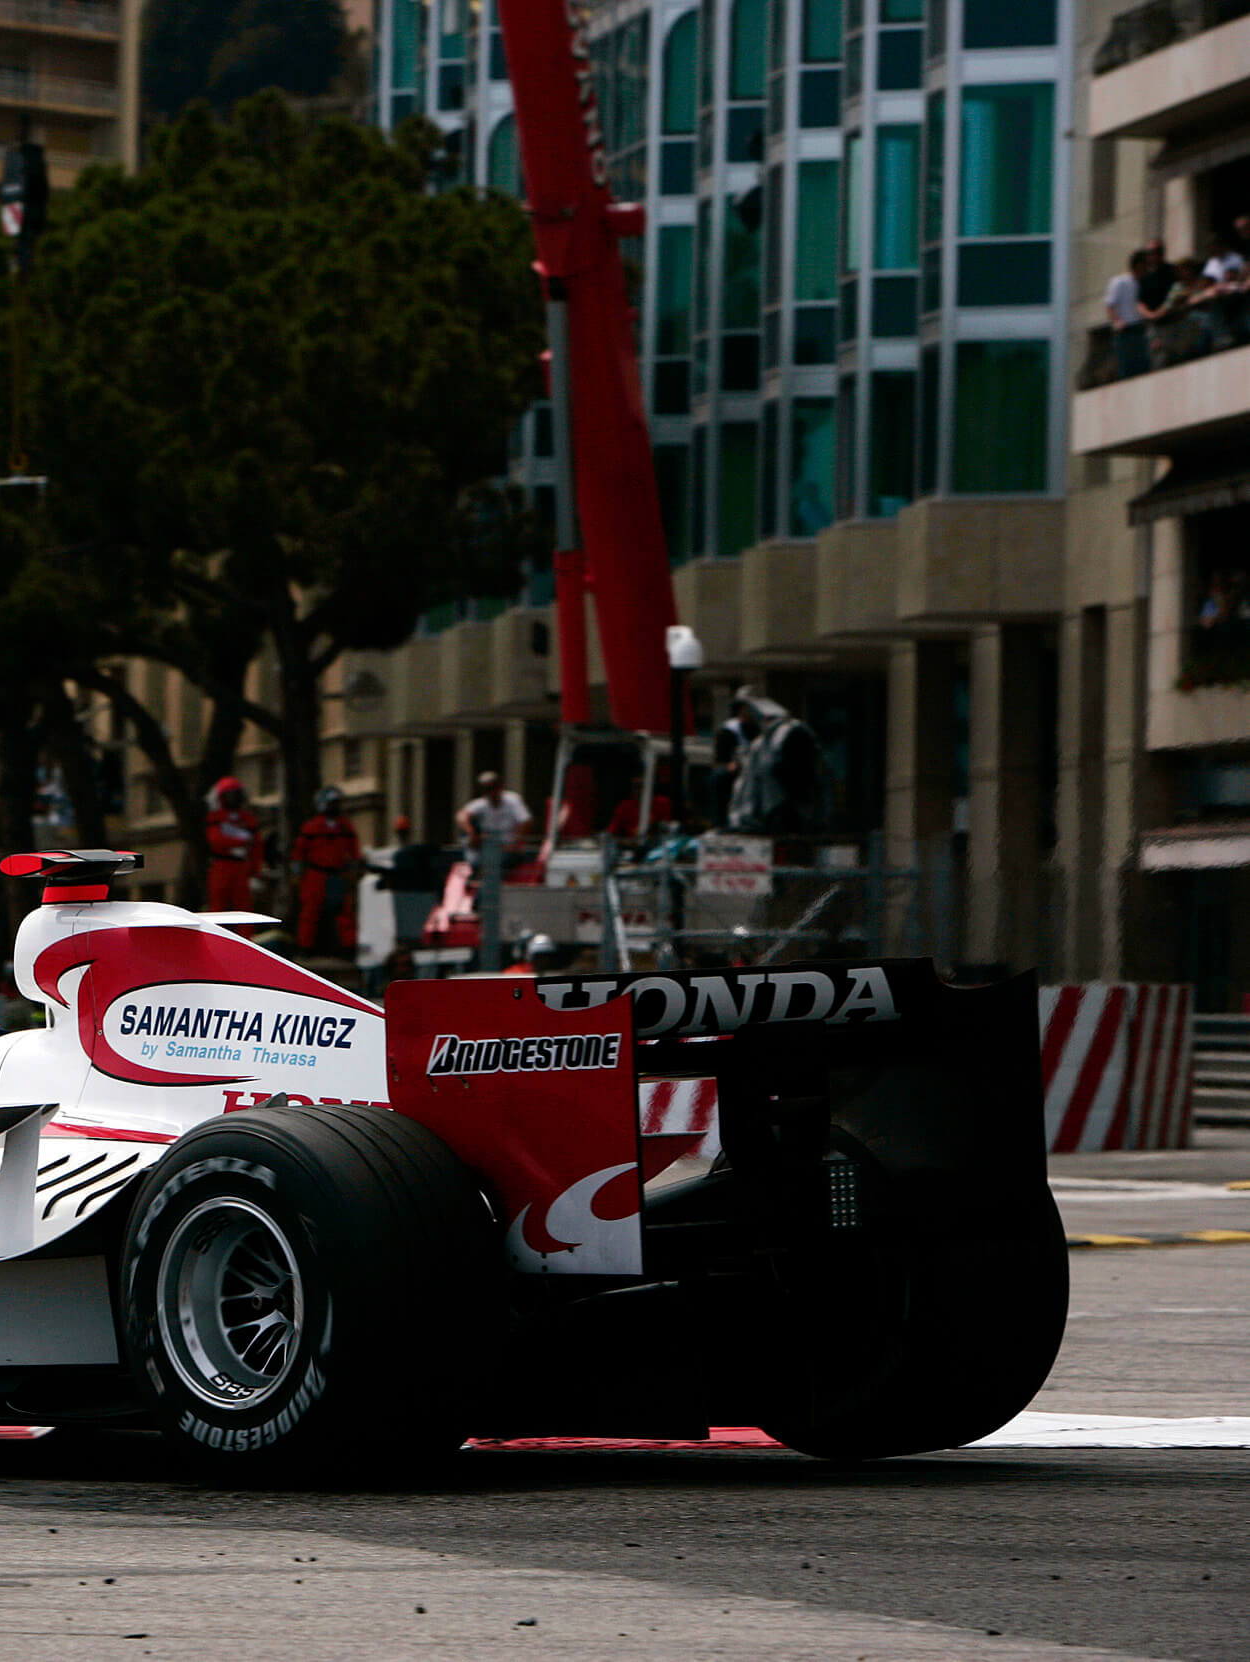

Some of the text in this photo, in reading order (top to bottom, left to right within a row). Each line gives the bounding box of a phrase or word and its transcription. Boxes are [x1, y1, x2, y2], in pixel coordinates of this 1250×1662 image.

[120, 1005, 356, 1049] SAMANTHA KINGZ
[141, 1041, 317, 1067] by Samantha Thavasa
[426, 1032, 623, 1077] BRIDGESTONE
